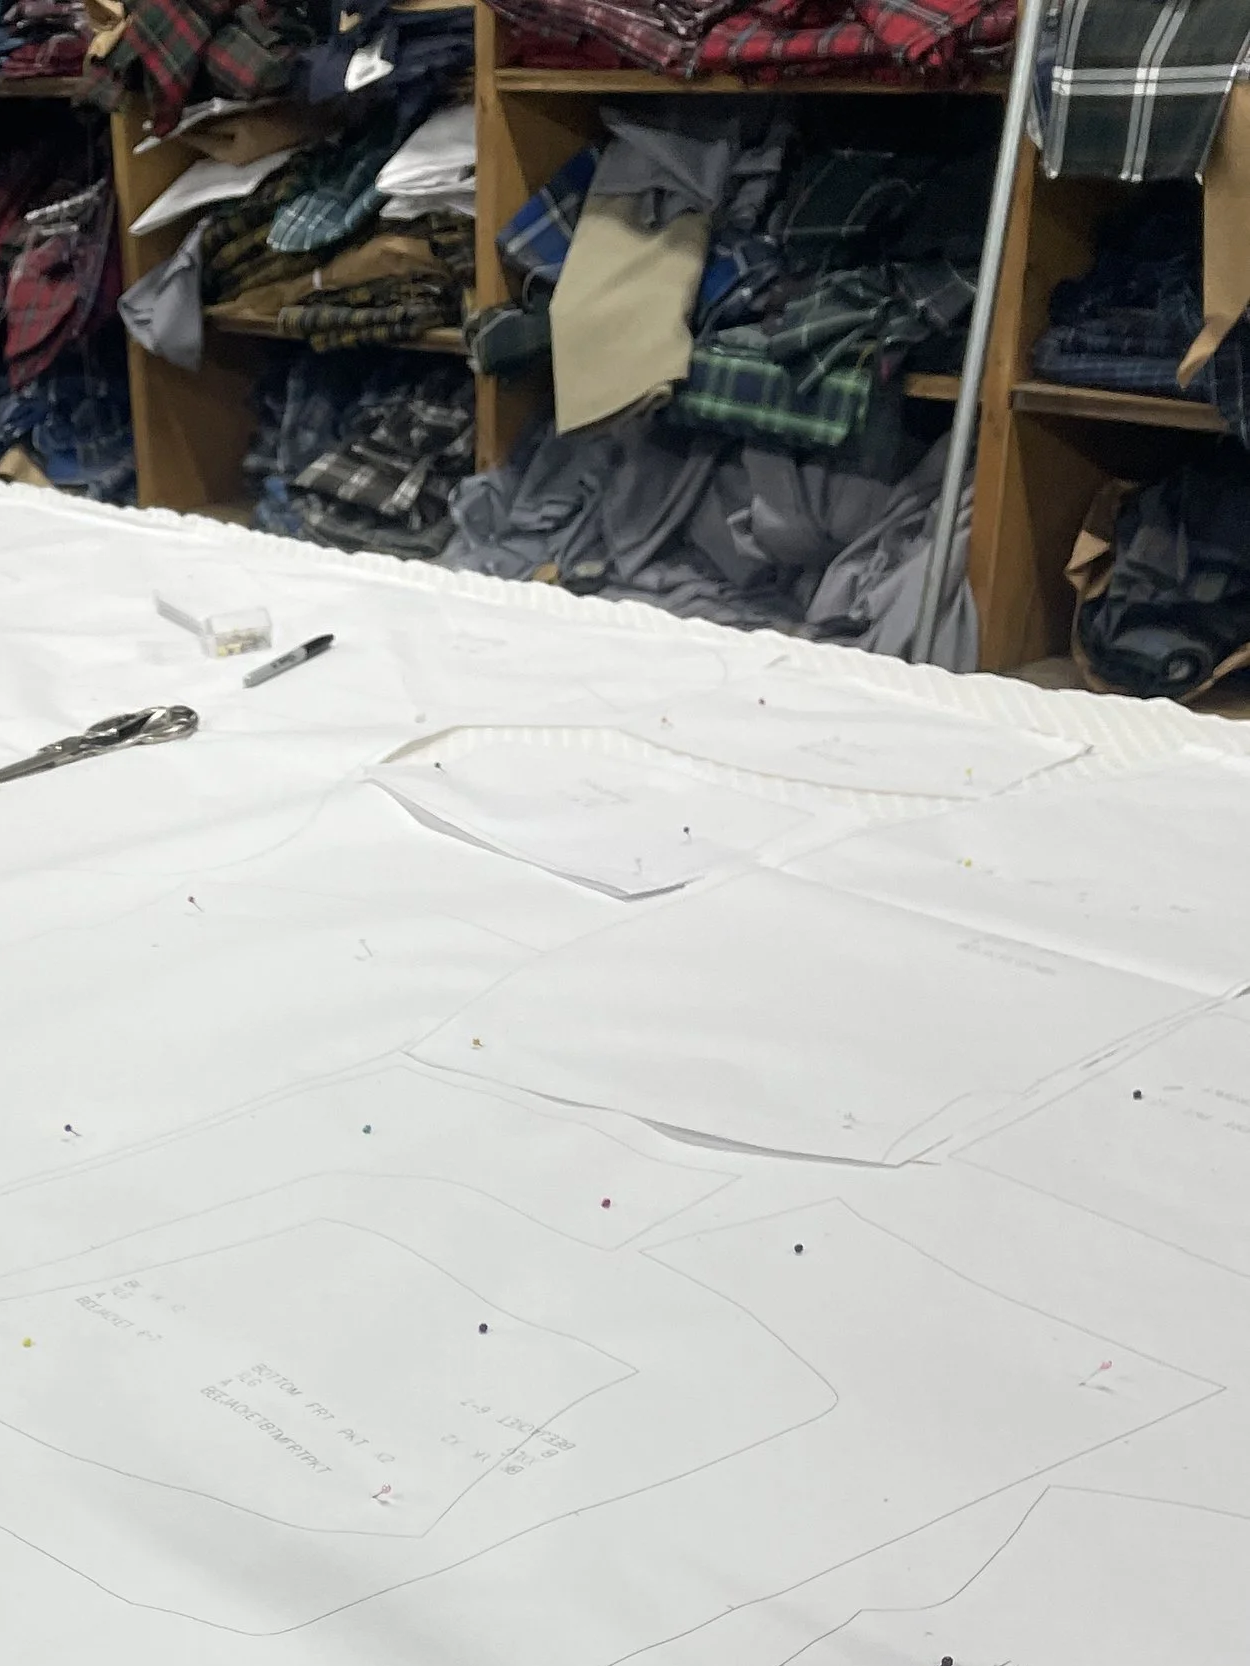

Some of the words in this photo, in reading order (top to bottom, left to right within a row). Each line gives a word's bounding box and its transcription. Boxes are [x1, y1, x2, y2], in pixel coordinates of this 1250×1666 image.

[251, 1363, 303, 1396] BOTTOM
[305, 1402, 335, 1421] FRT
[338, 1428, 370, 1447] PKT
